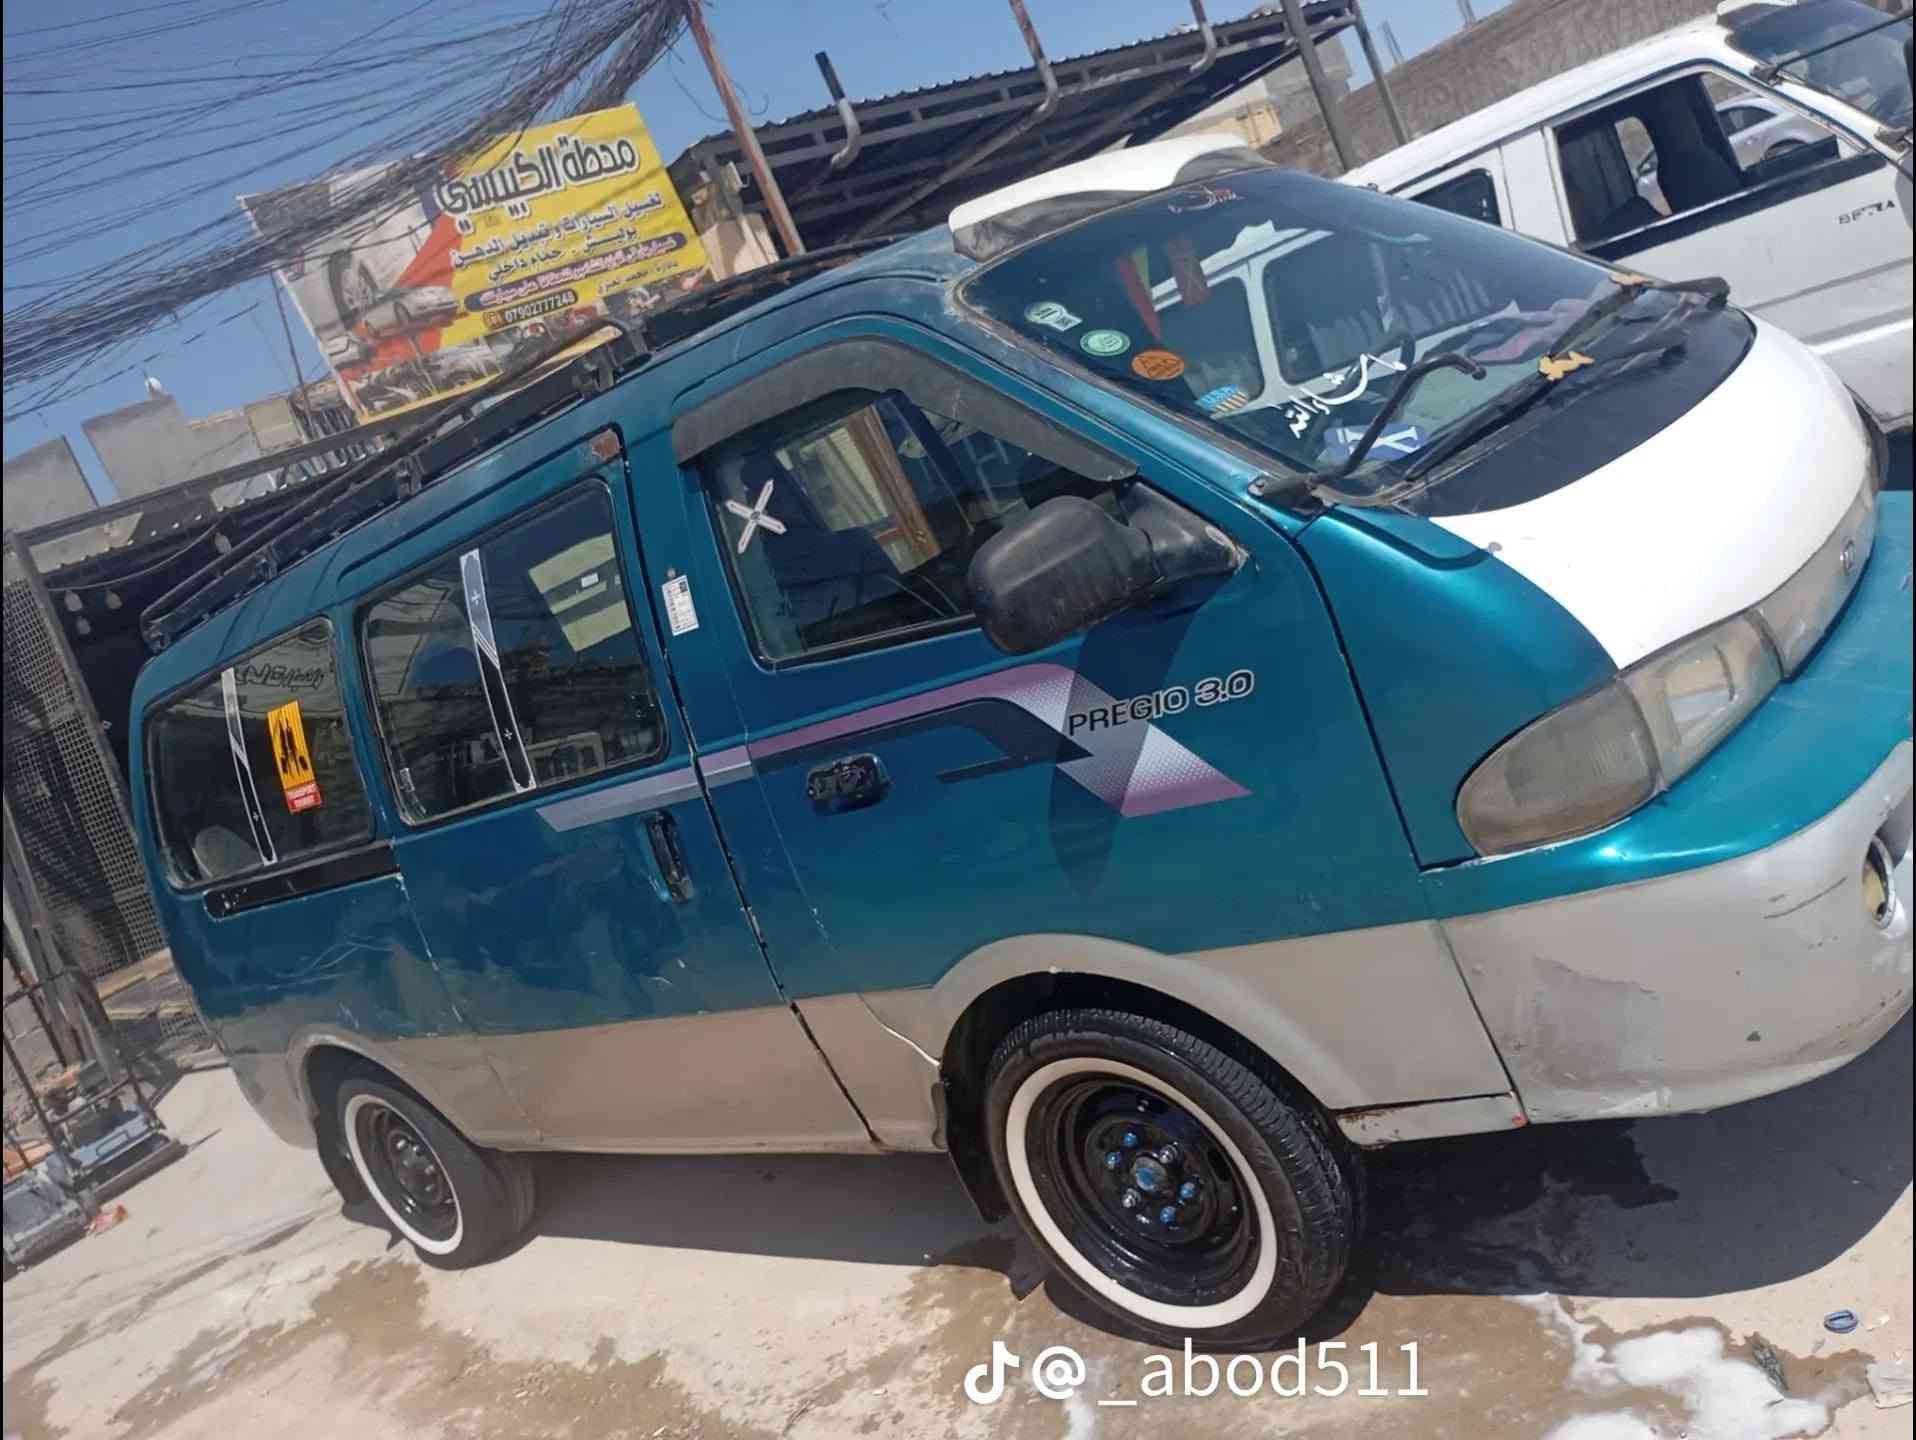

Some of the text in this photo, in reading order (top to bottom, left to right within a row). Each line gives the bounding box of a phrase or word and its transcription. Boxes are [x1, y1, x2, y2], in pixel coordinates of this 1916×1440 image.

[561, 136, 638, 182] محطة
[1067, 668, 1255, 737] PREGIO 3.0
